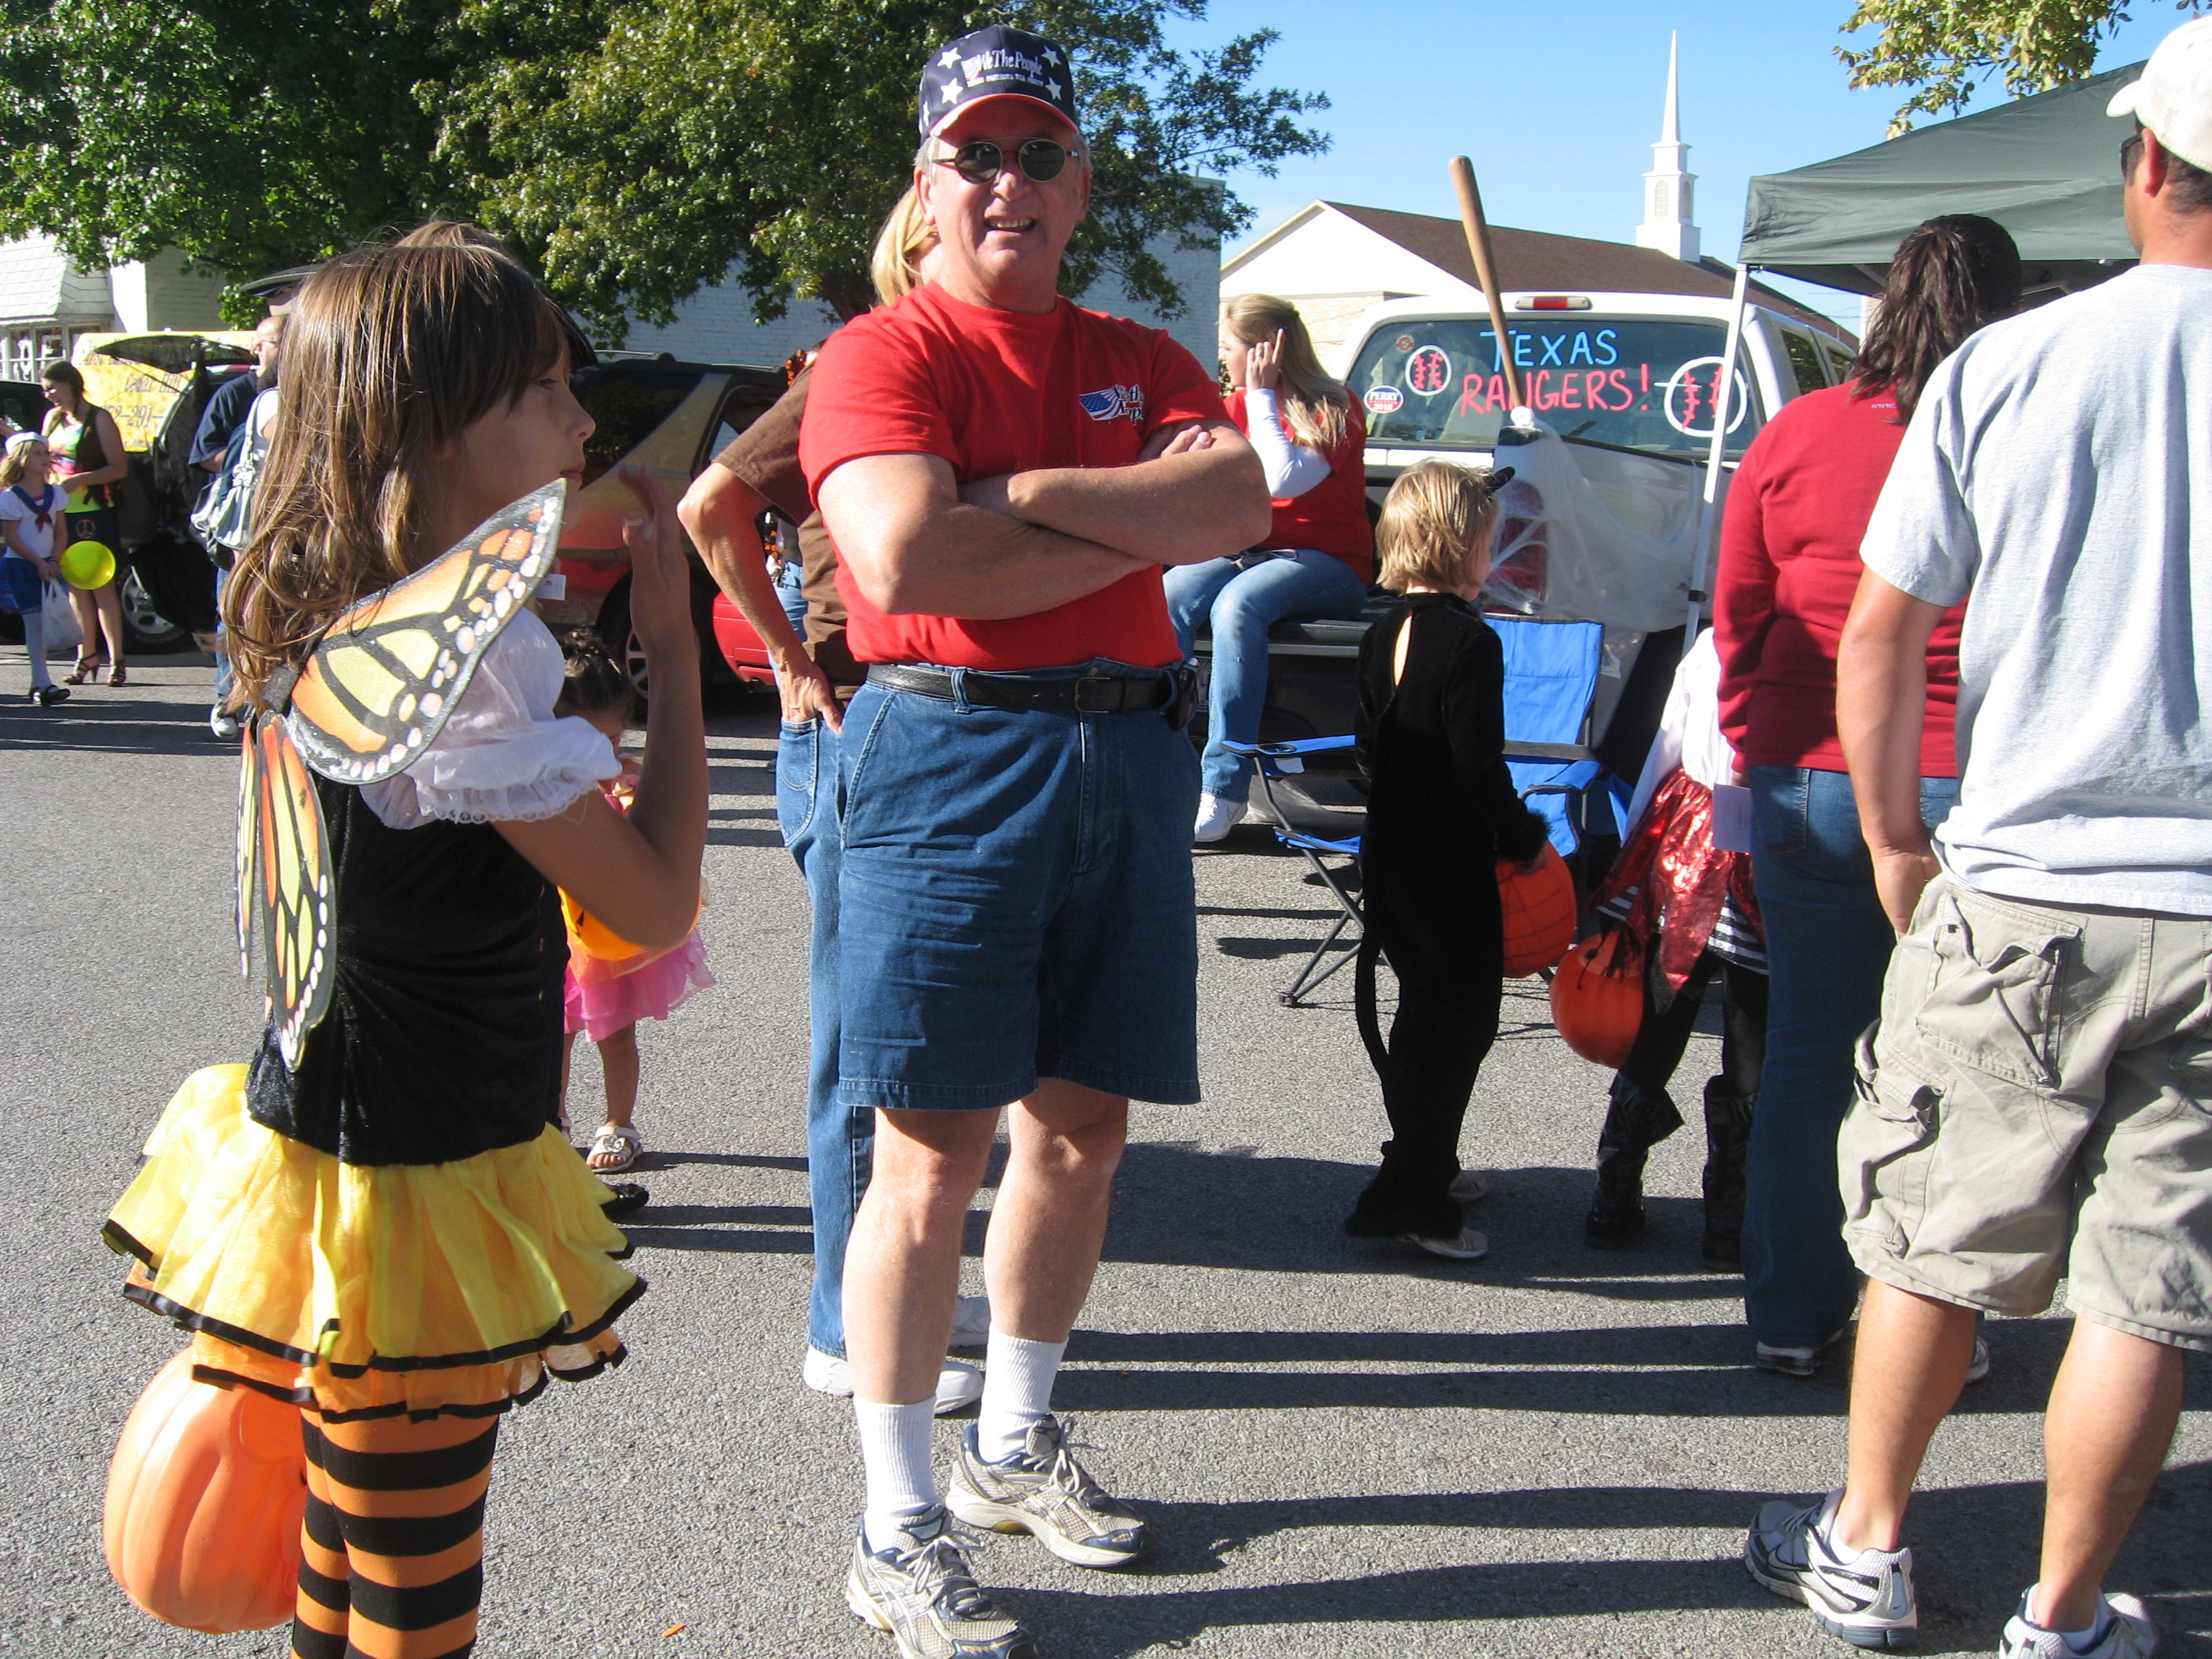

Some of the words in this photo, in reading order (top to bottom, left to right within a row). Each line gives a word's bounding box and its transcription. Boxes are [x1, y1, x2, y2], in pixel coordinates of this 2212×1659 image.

[978, 51, 992, 70] We
[992, 48, 1015, 68] The
[1015, 51, 1043, 77] People
[1480, 328, 1617, 372] TEXAS
[1370, 391, 1401, 401] PERRY
